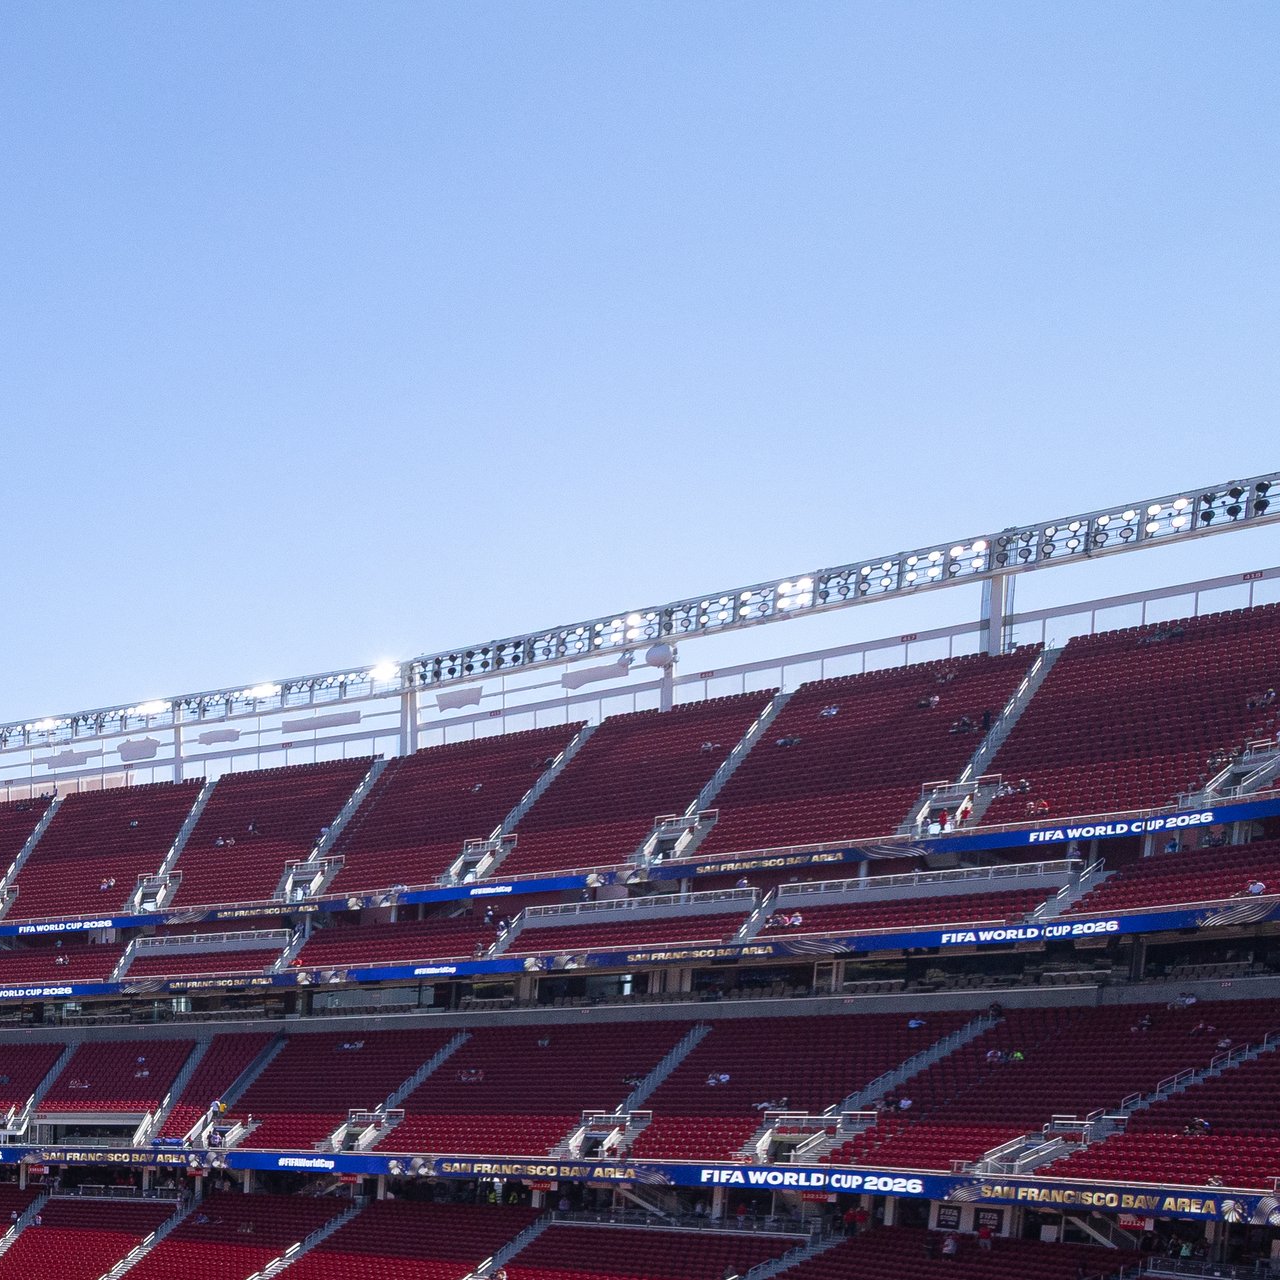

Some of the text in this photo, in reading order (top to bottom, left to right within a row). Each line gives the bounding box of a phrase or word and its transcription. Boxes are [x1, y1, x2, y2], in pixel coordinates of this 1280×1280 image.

[1029, 811, 1214, 844] FIFA WORLD CUP 2026
[697, 853, 843, 874] SAN FRANCISCO BAY AREA
[19, 921, 112, 934] FIFA WORLD CUP 2026
[941, 920, 1118, 944] FIFA WORLD CUP 2026
[627, 945, 773, 962] SAN FRANCISCO BAY AREA
[26, 988, 42, 996] CUP
[43, 987, 72, 996] 2026
[43, 1152, 186, 1164] SAN FRANCISCO BAY AREA
[278, 1158, 335, 1169] #FIFAWorldCup
[442, 1163, 636, 1179] SAN FRANCISCO BAY AREA
[701, 1170, 923, 1193] FIFA WORLD CUP 2026
[981, 1185, 1216, 1215] SAN FRANCISCO BAY AREA
